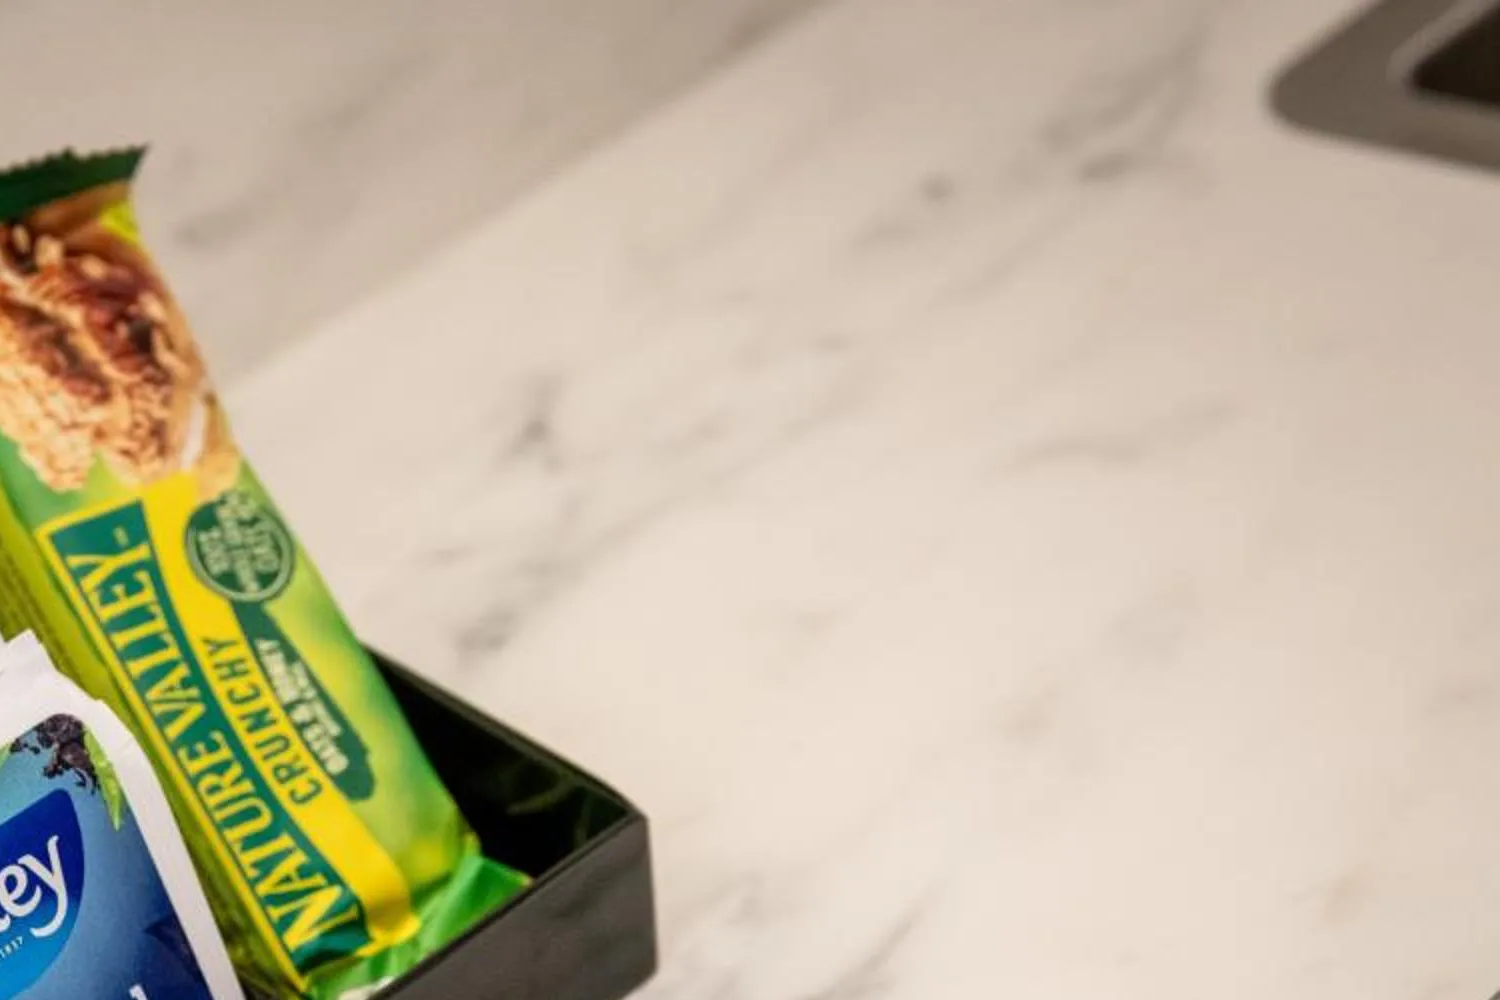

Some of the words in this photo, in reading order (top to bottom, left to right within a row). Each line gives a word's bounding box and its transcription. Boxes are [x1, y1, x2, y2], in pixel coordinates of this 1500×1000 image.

[67, 542, 207, 739] VALLEY
[202, 636, 323, 802] CRUNCHY
[177, 731, 361, 952] NATURE
